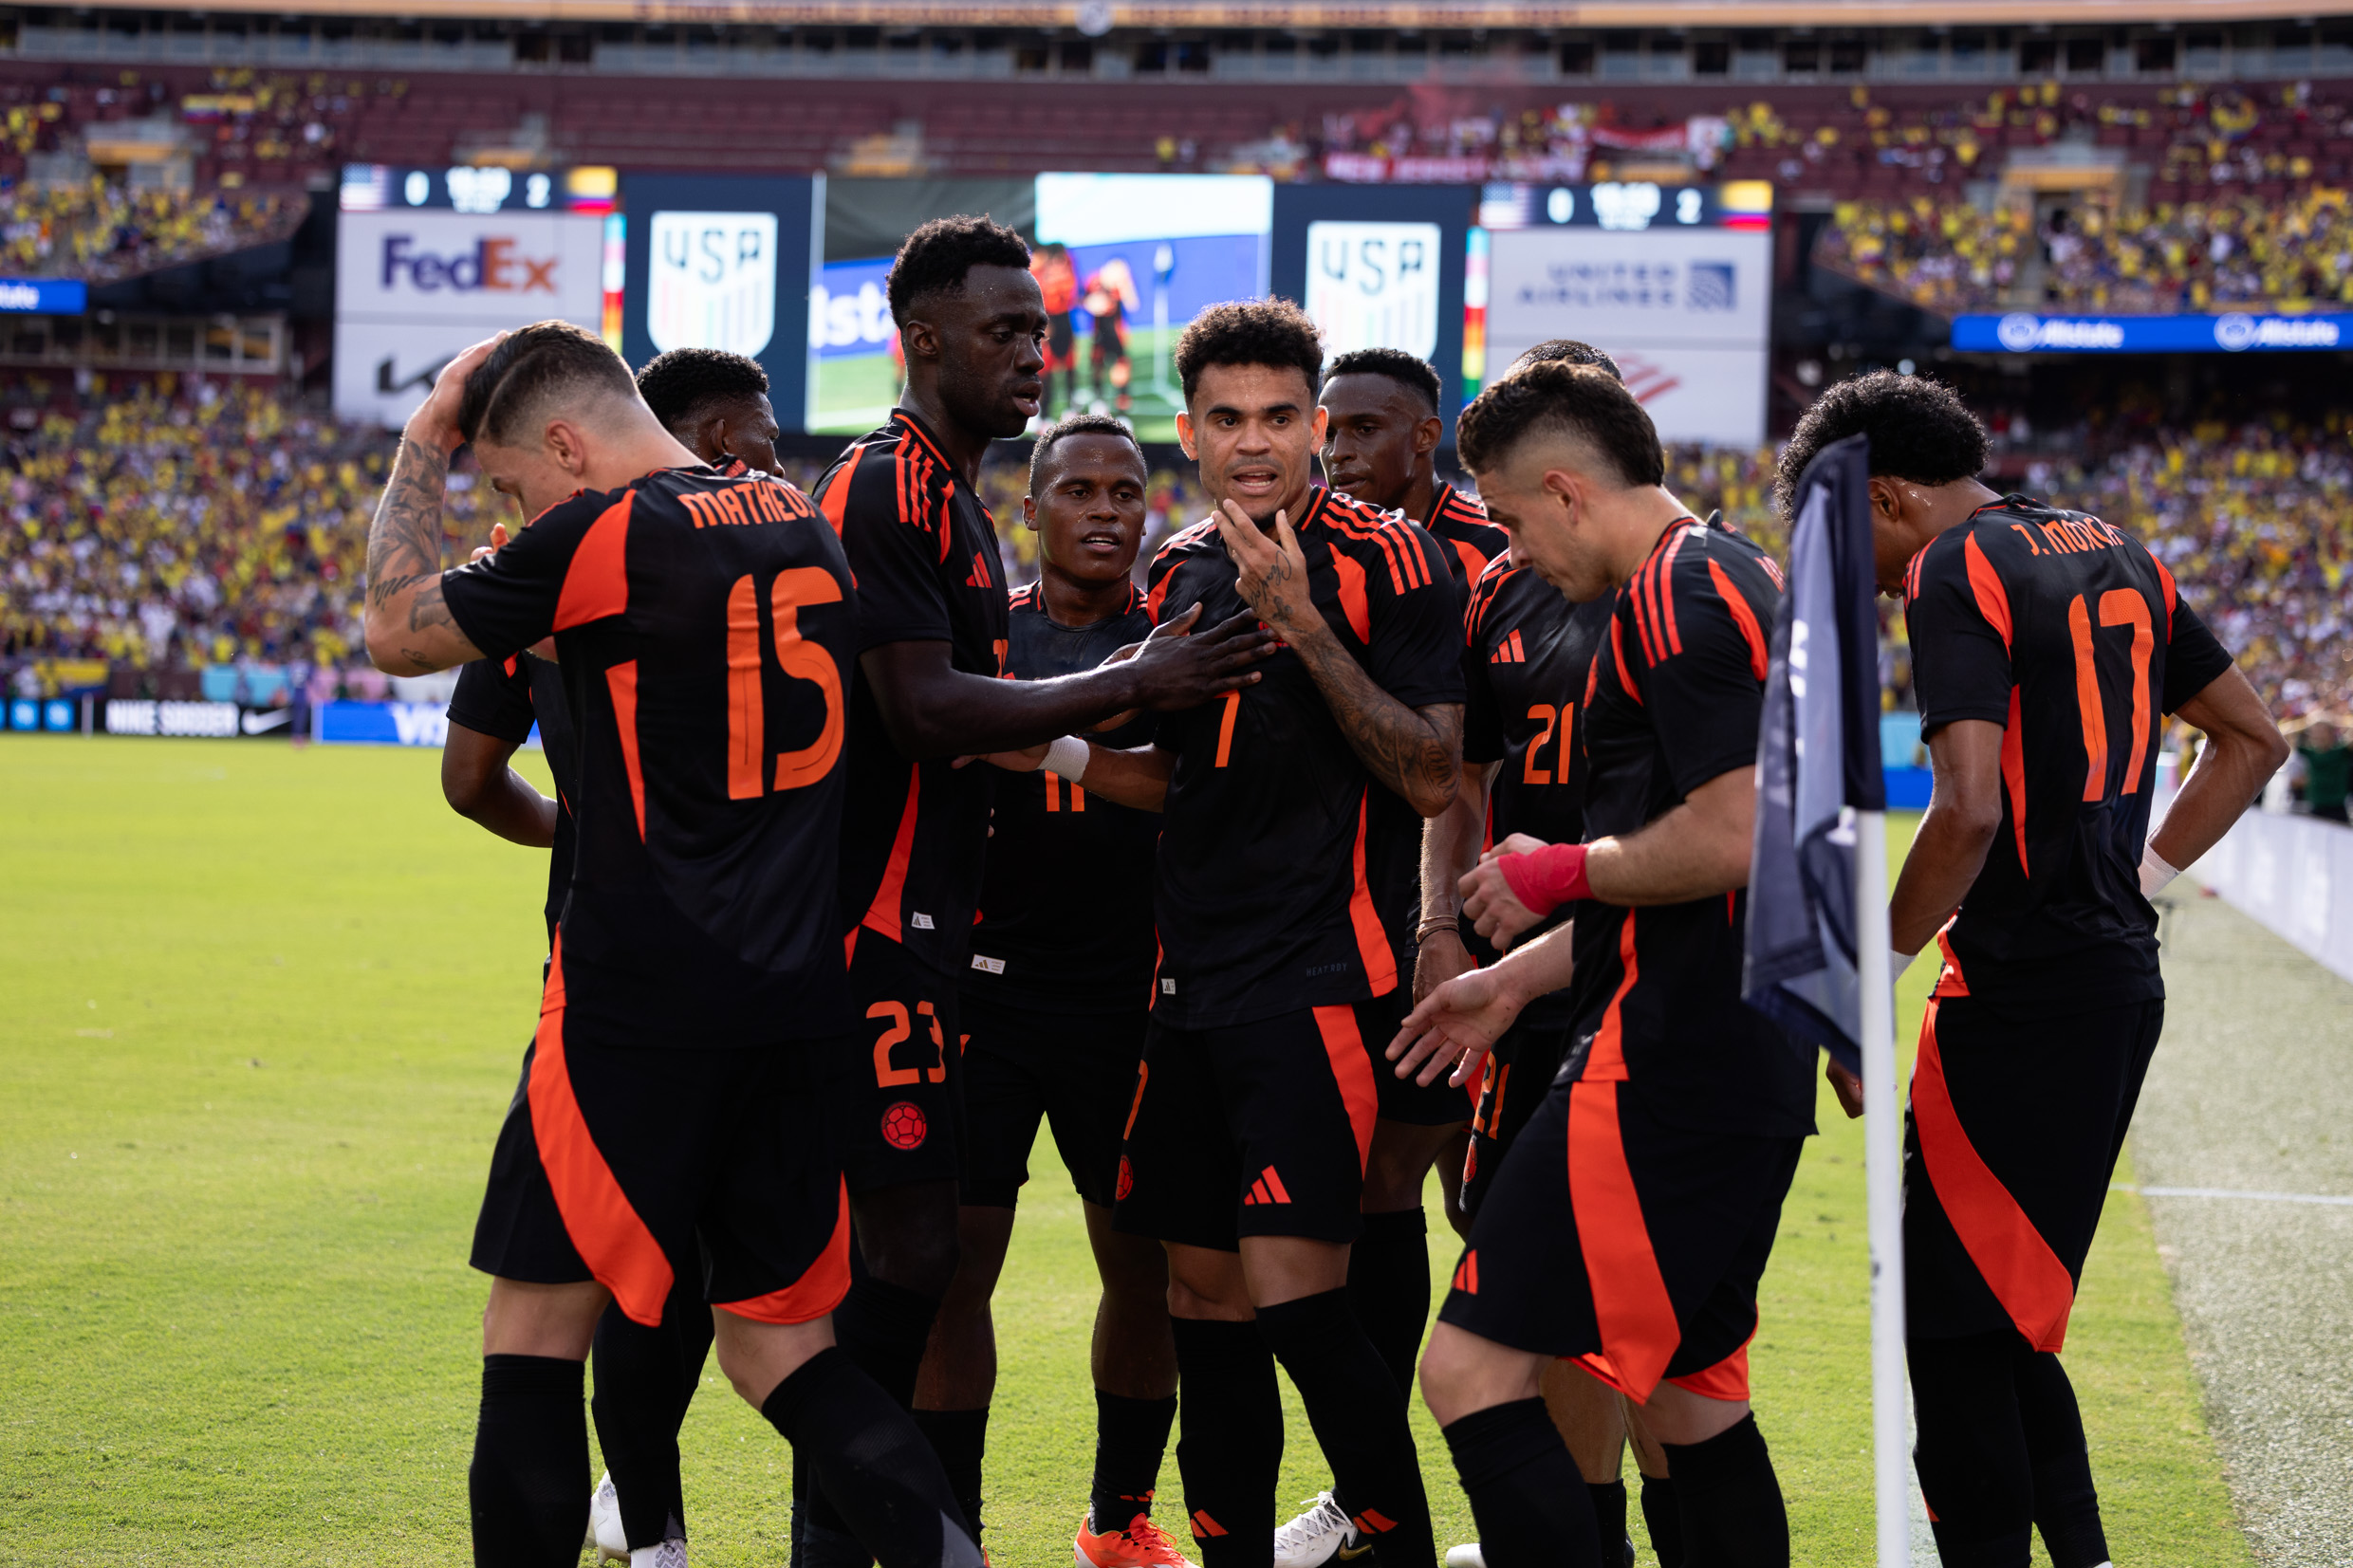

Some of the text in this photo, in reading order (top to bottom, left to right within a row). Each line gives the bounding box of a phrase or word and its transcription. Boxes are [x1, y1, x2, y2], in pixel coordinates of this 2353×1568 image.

[380, 234, 559, 295] FedEx
[663, 229, 762, 285] USA
[1322, 239, 1425, 296] USA
[1547, 260, 1677, 282] UNITED
[1517, 285, 1677, 306] AIRLINES
[676, 480, 816, 529] MATHEU
[727, 566, 844, 800] 15
[2068, 588, 2154, 802] 17
[105, 698, 158, 735] NIKE
[1214, 689, 1240, 767] 7
[1523, 702, 1574, 784] 21
[865, 1001, 946, 1088] 23
